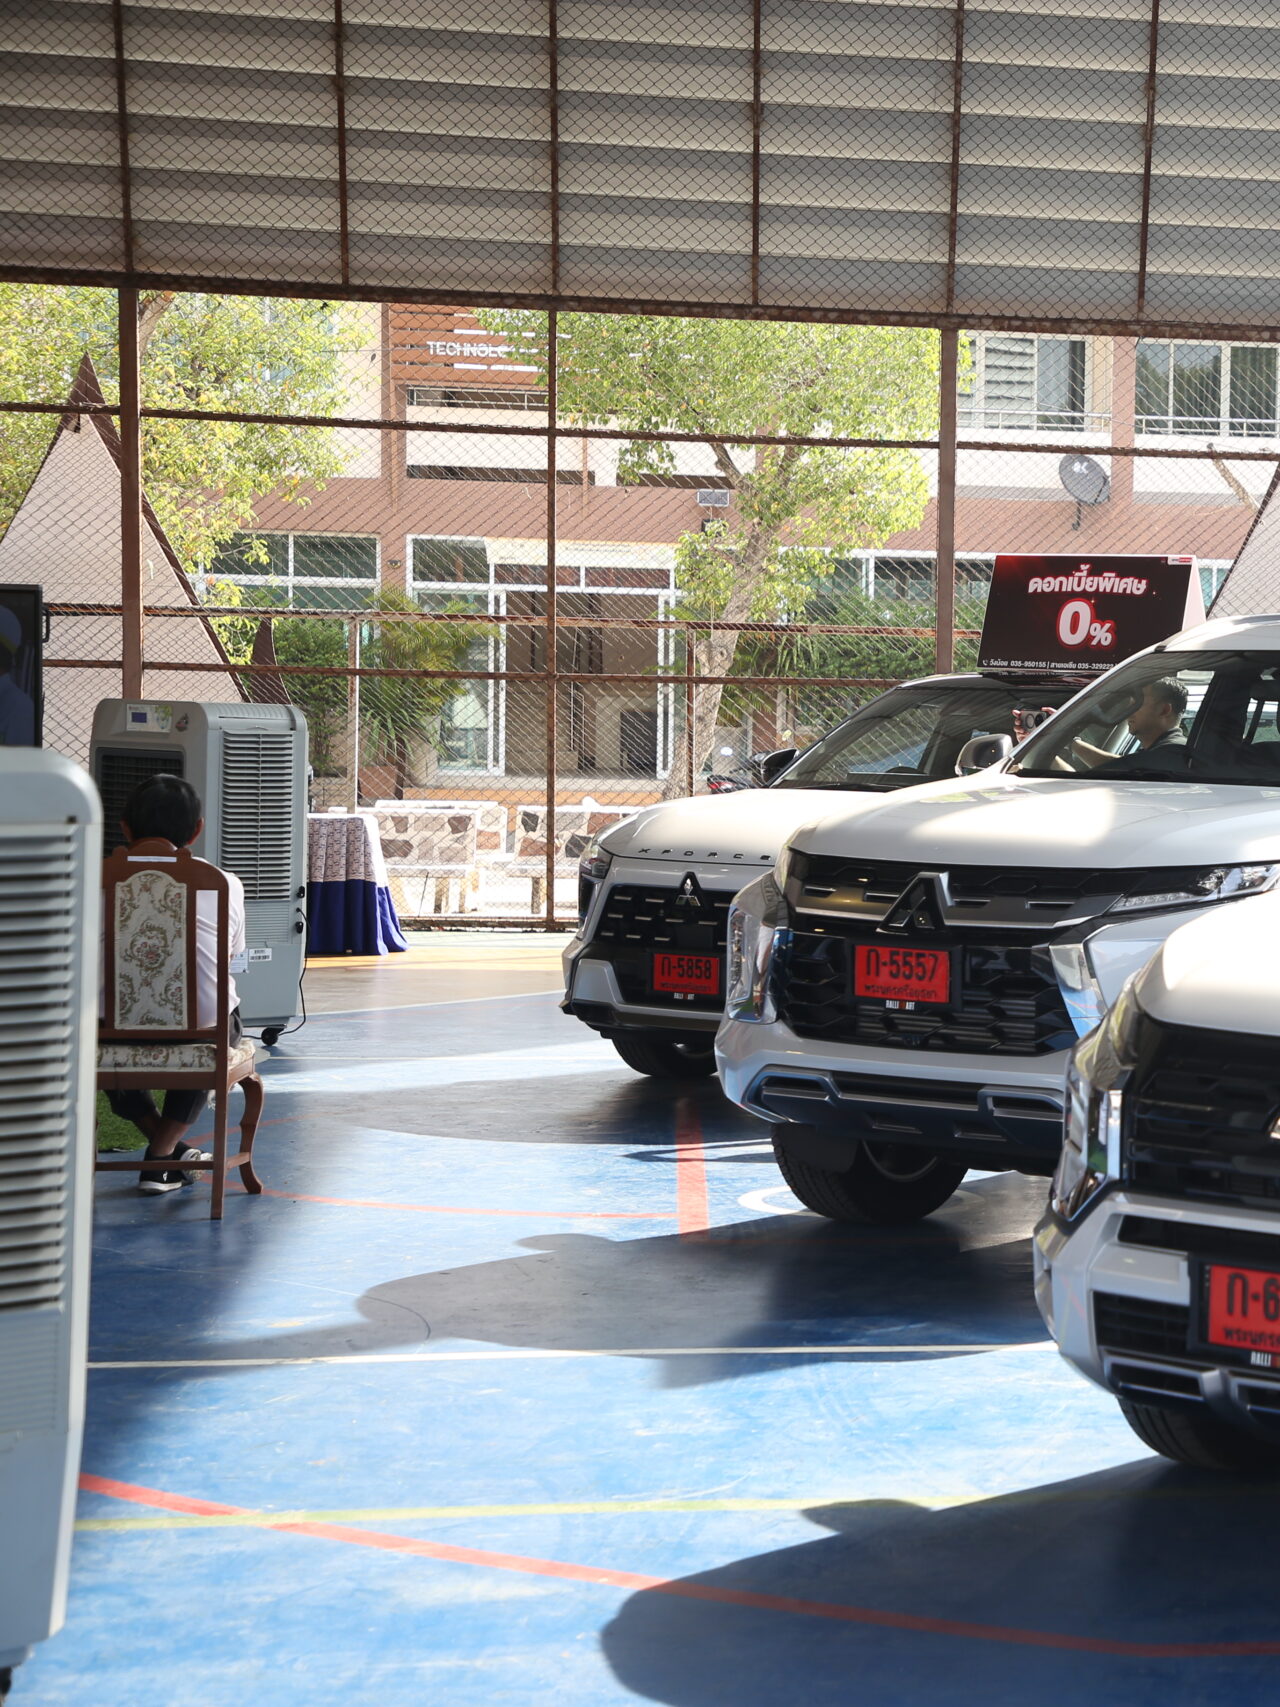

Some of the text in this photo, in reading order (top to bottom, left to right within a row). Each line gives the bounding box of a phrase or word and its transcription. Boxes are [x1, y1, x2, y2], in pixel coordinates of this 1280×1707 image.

[1028, 564, 1147, 595] ดอกเบี้ยพิเศษ
[1059, 600, 1112, 646] 0%
